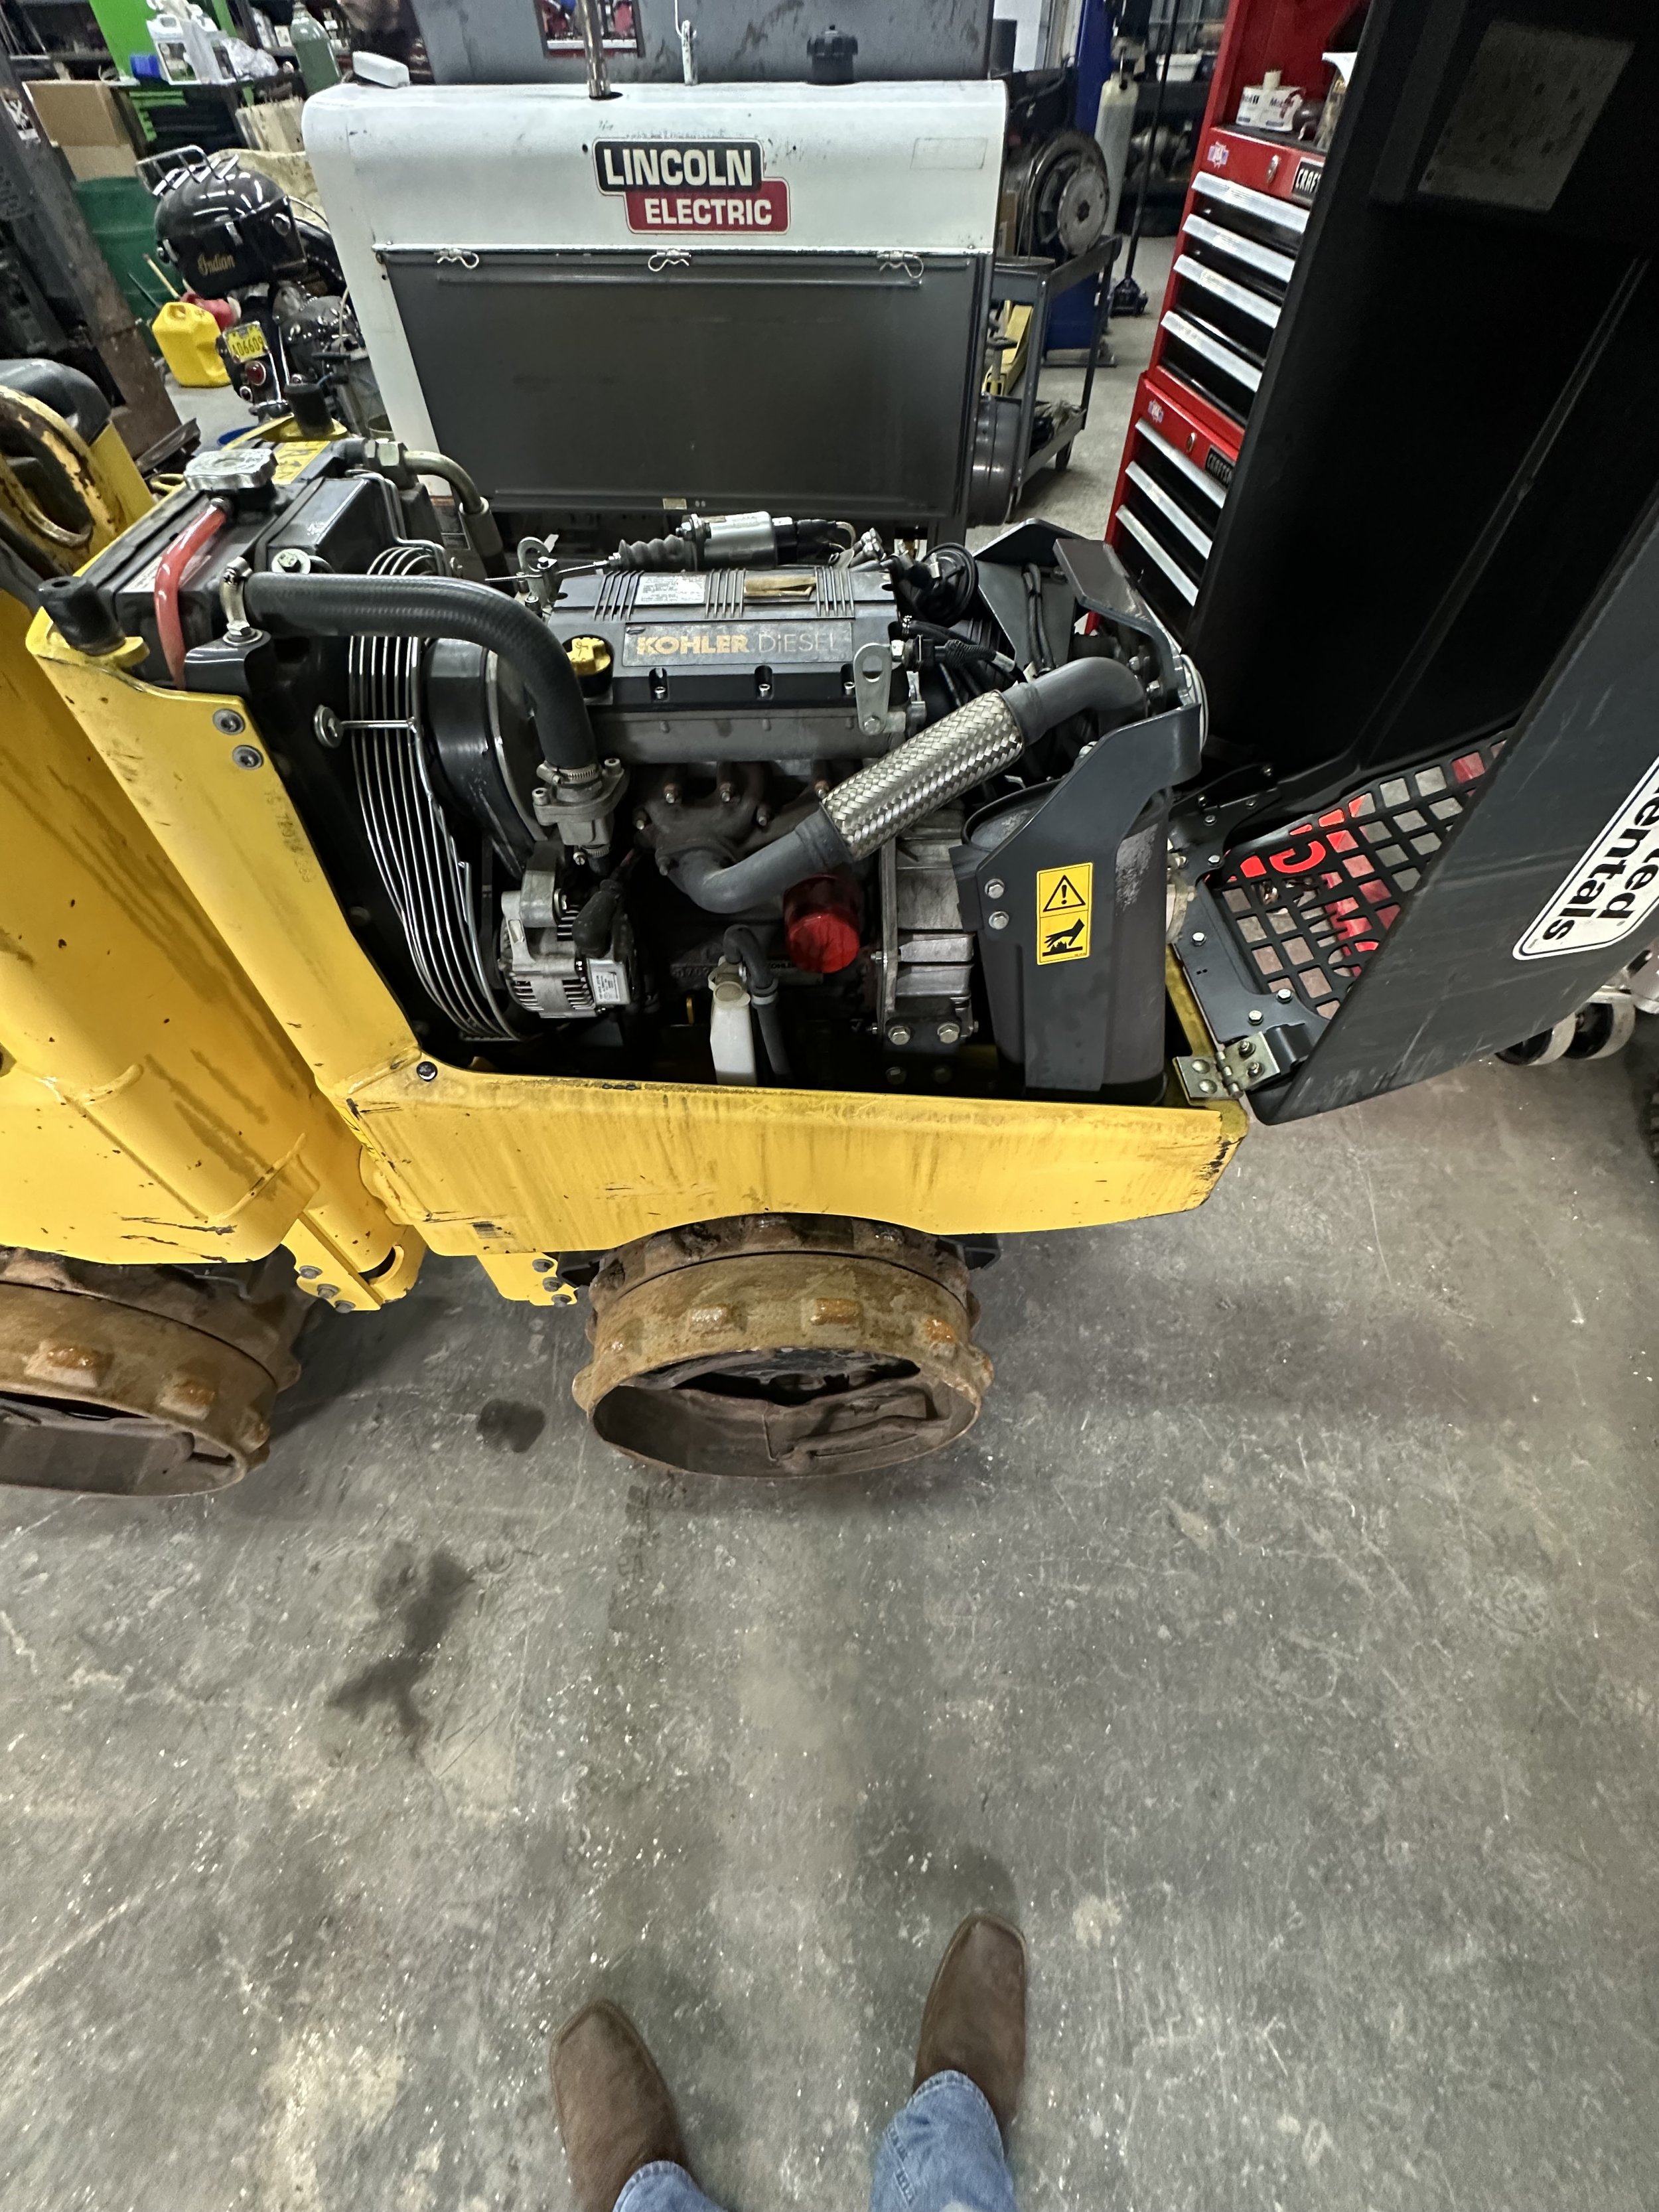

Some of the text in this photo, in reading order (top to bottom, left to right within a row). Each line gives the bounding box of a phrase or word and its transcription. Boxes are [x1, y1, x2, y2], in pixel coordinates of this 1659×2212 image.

[603, 148, 753, 186] LINCOLN
[644, 198, 772, 225] ELECTRIC
[197, 253, 236, 277] Indian
[636, 633, 749, 656] KOHLER
[1542, 786, 1659, 940] entals
